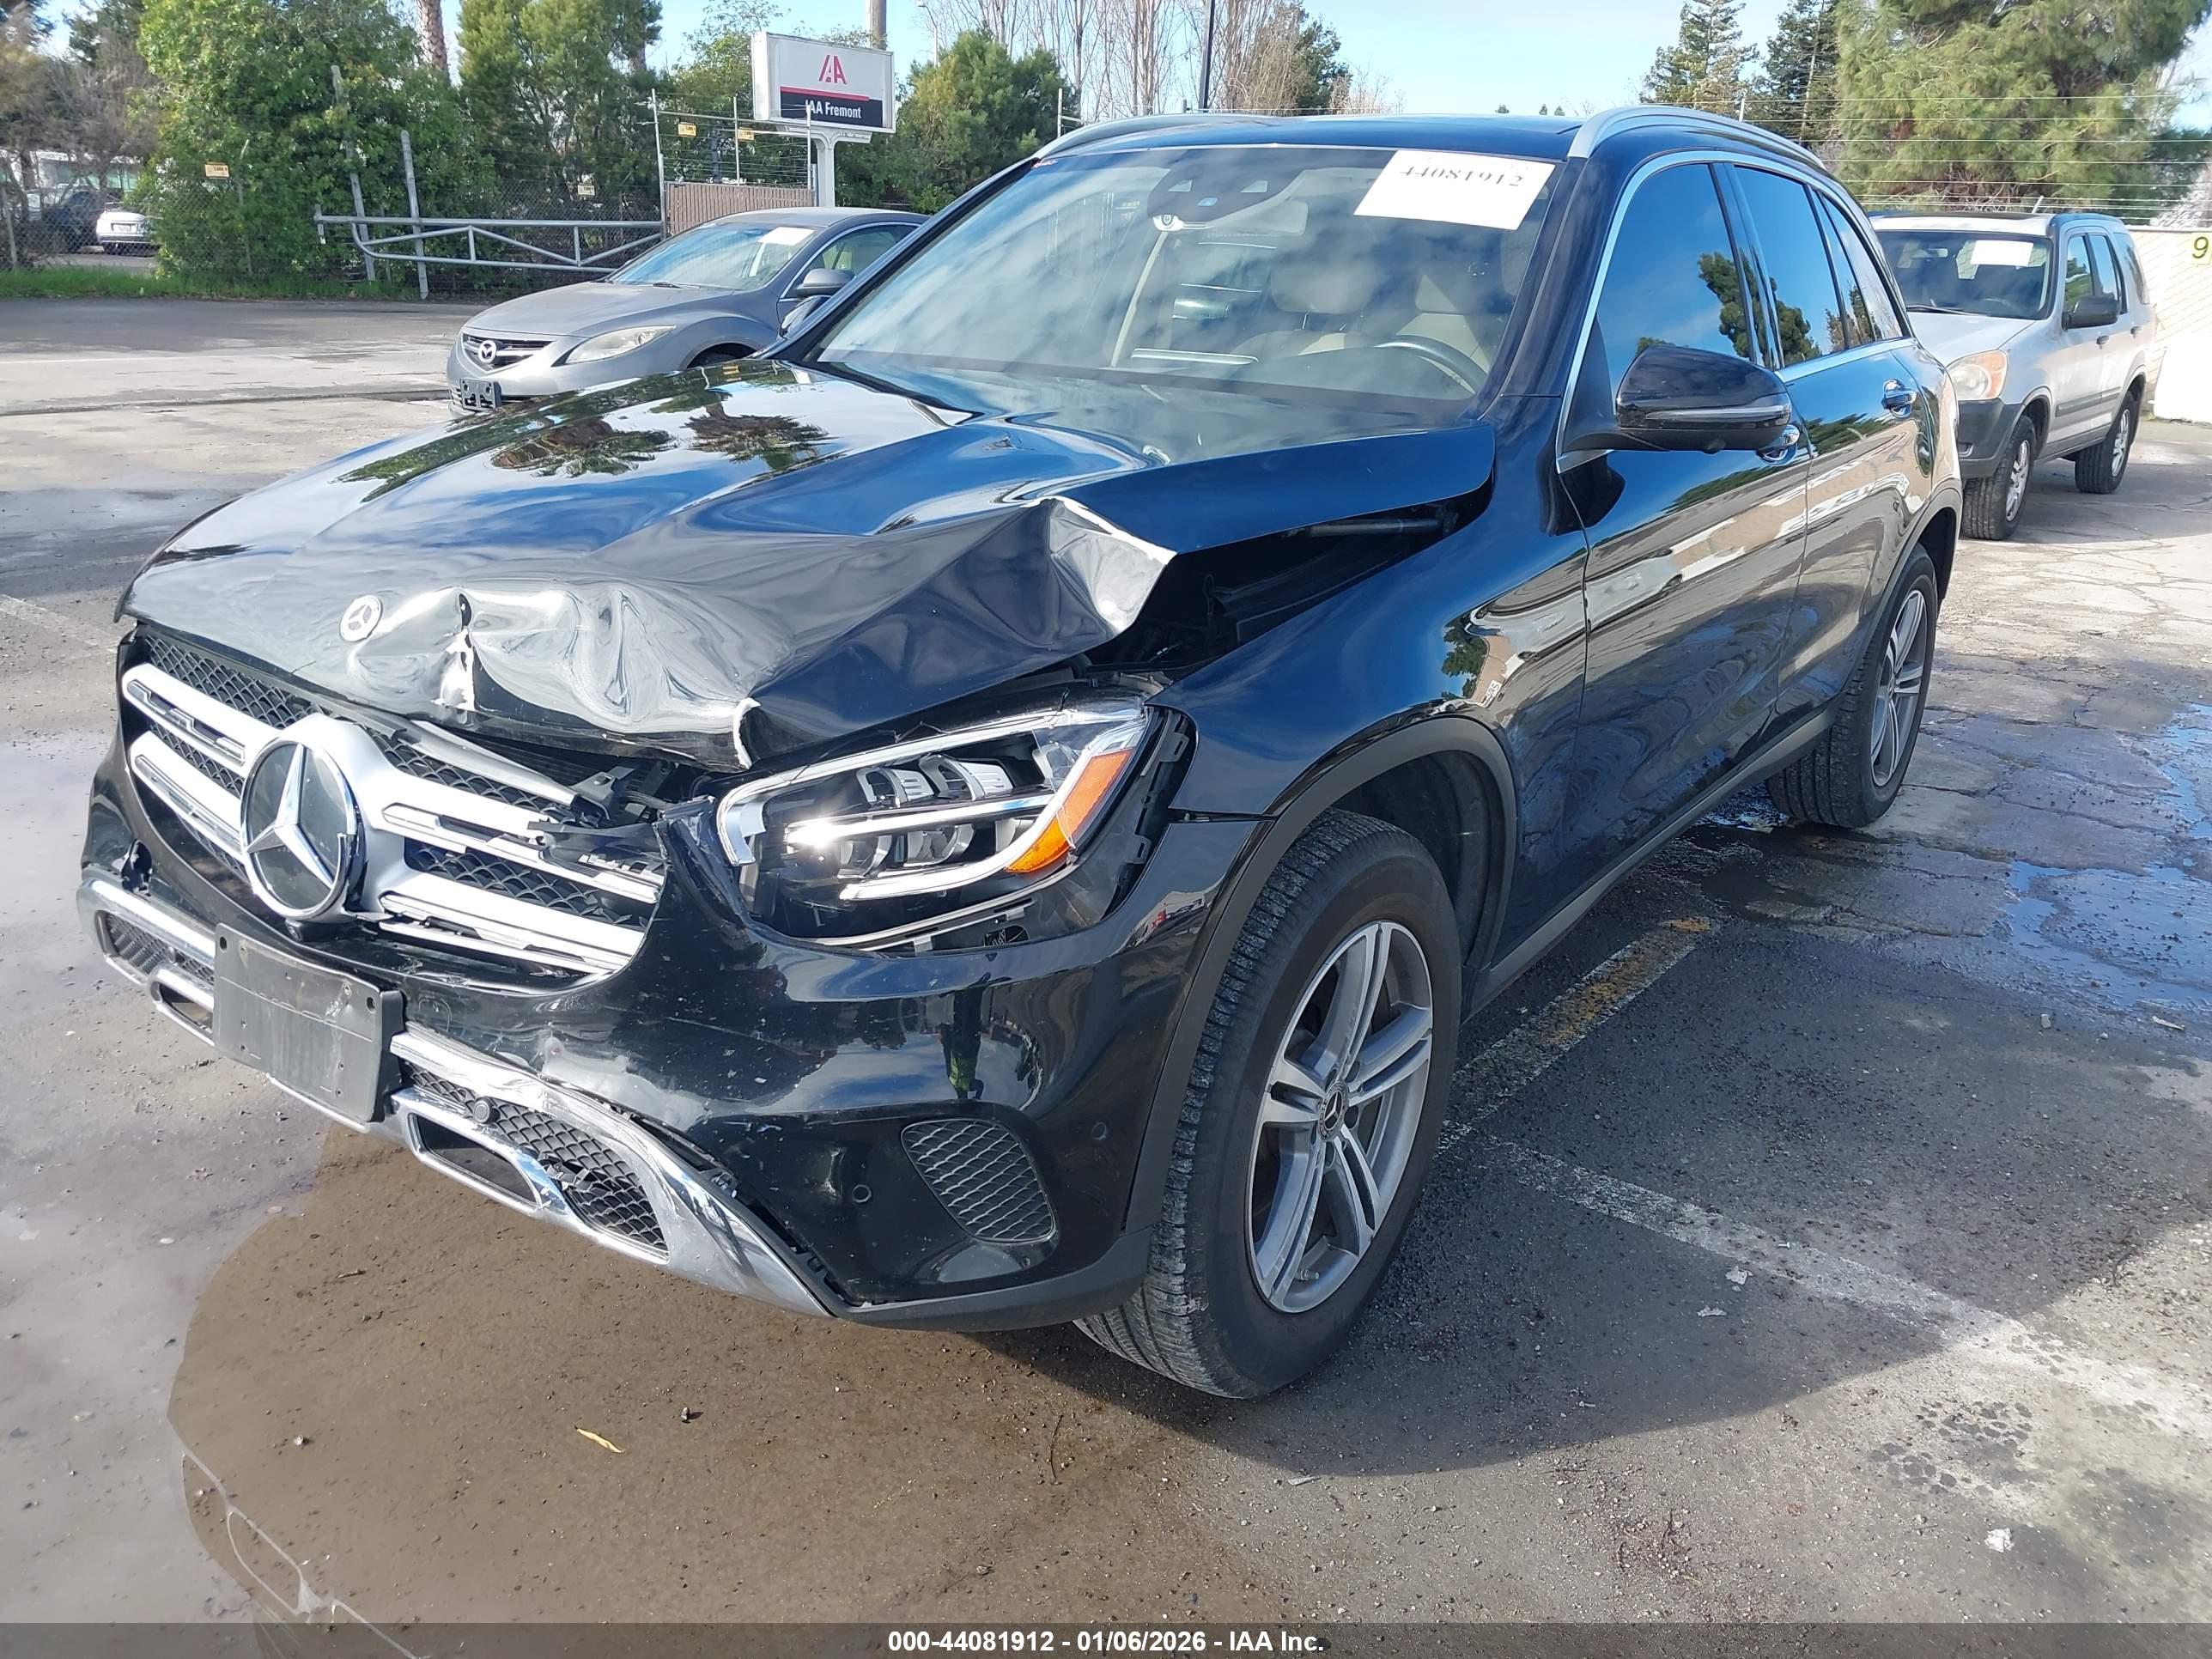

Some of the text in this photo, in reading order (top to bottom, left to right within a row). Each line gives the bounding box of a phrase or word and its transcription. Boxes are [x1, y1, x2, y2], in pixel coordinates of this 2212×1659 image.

[824, 101, 862, 119] Fremont
[1400, 166, 1524, 187] 44081912
[2191, 235, 2209, 259] 9
